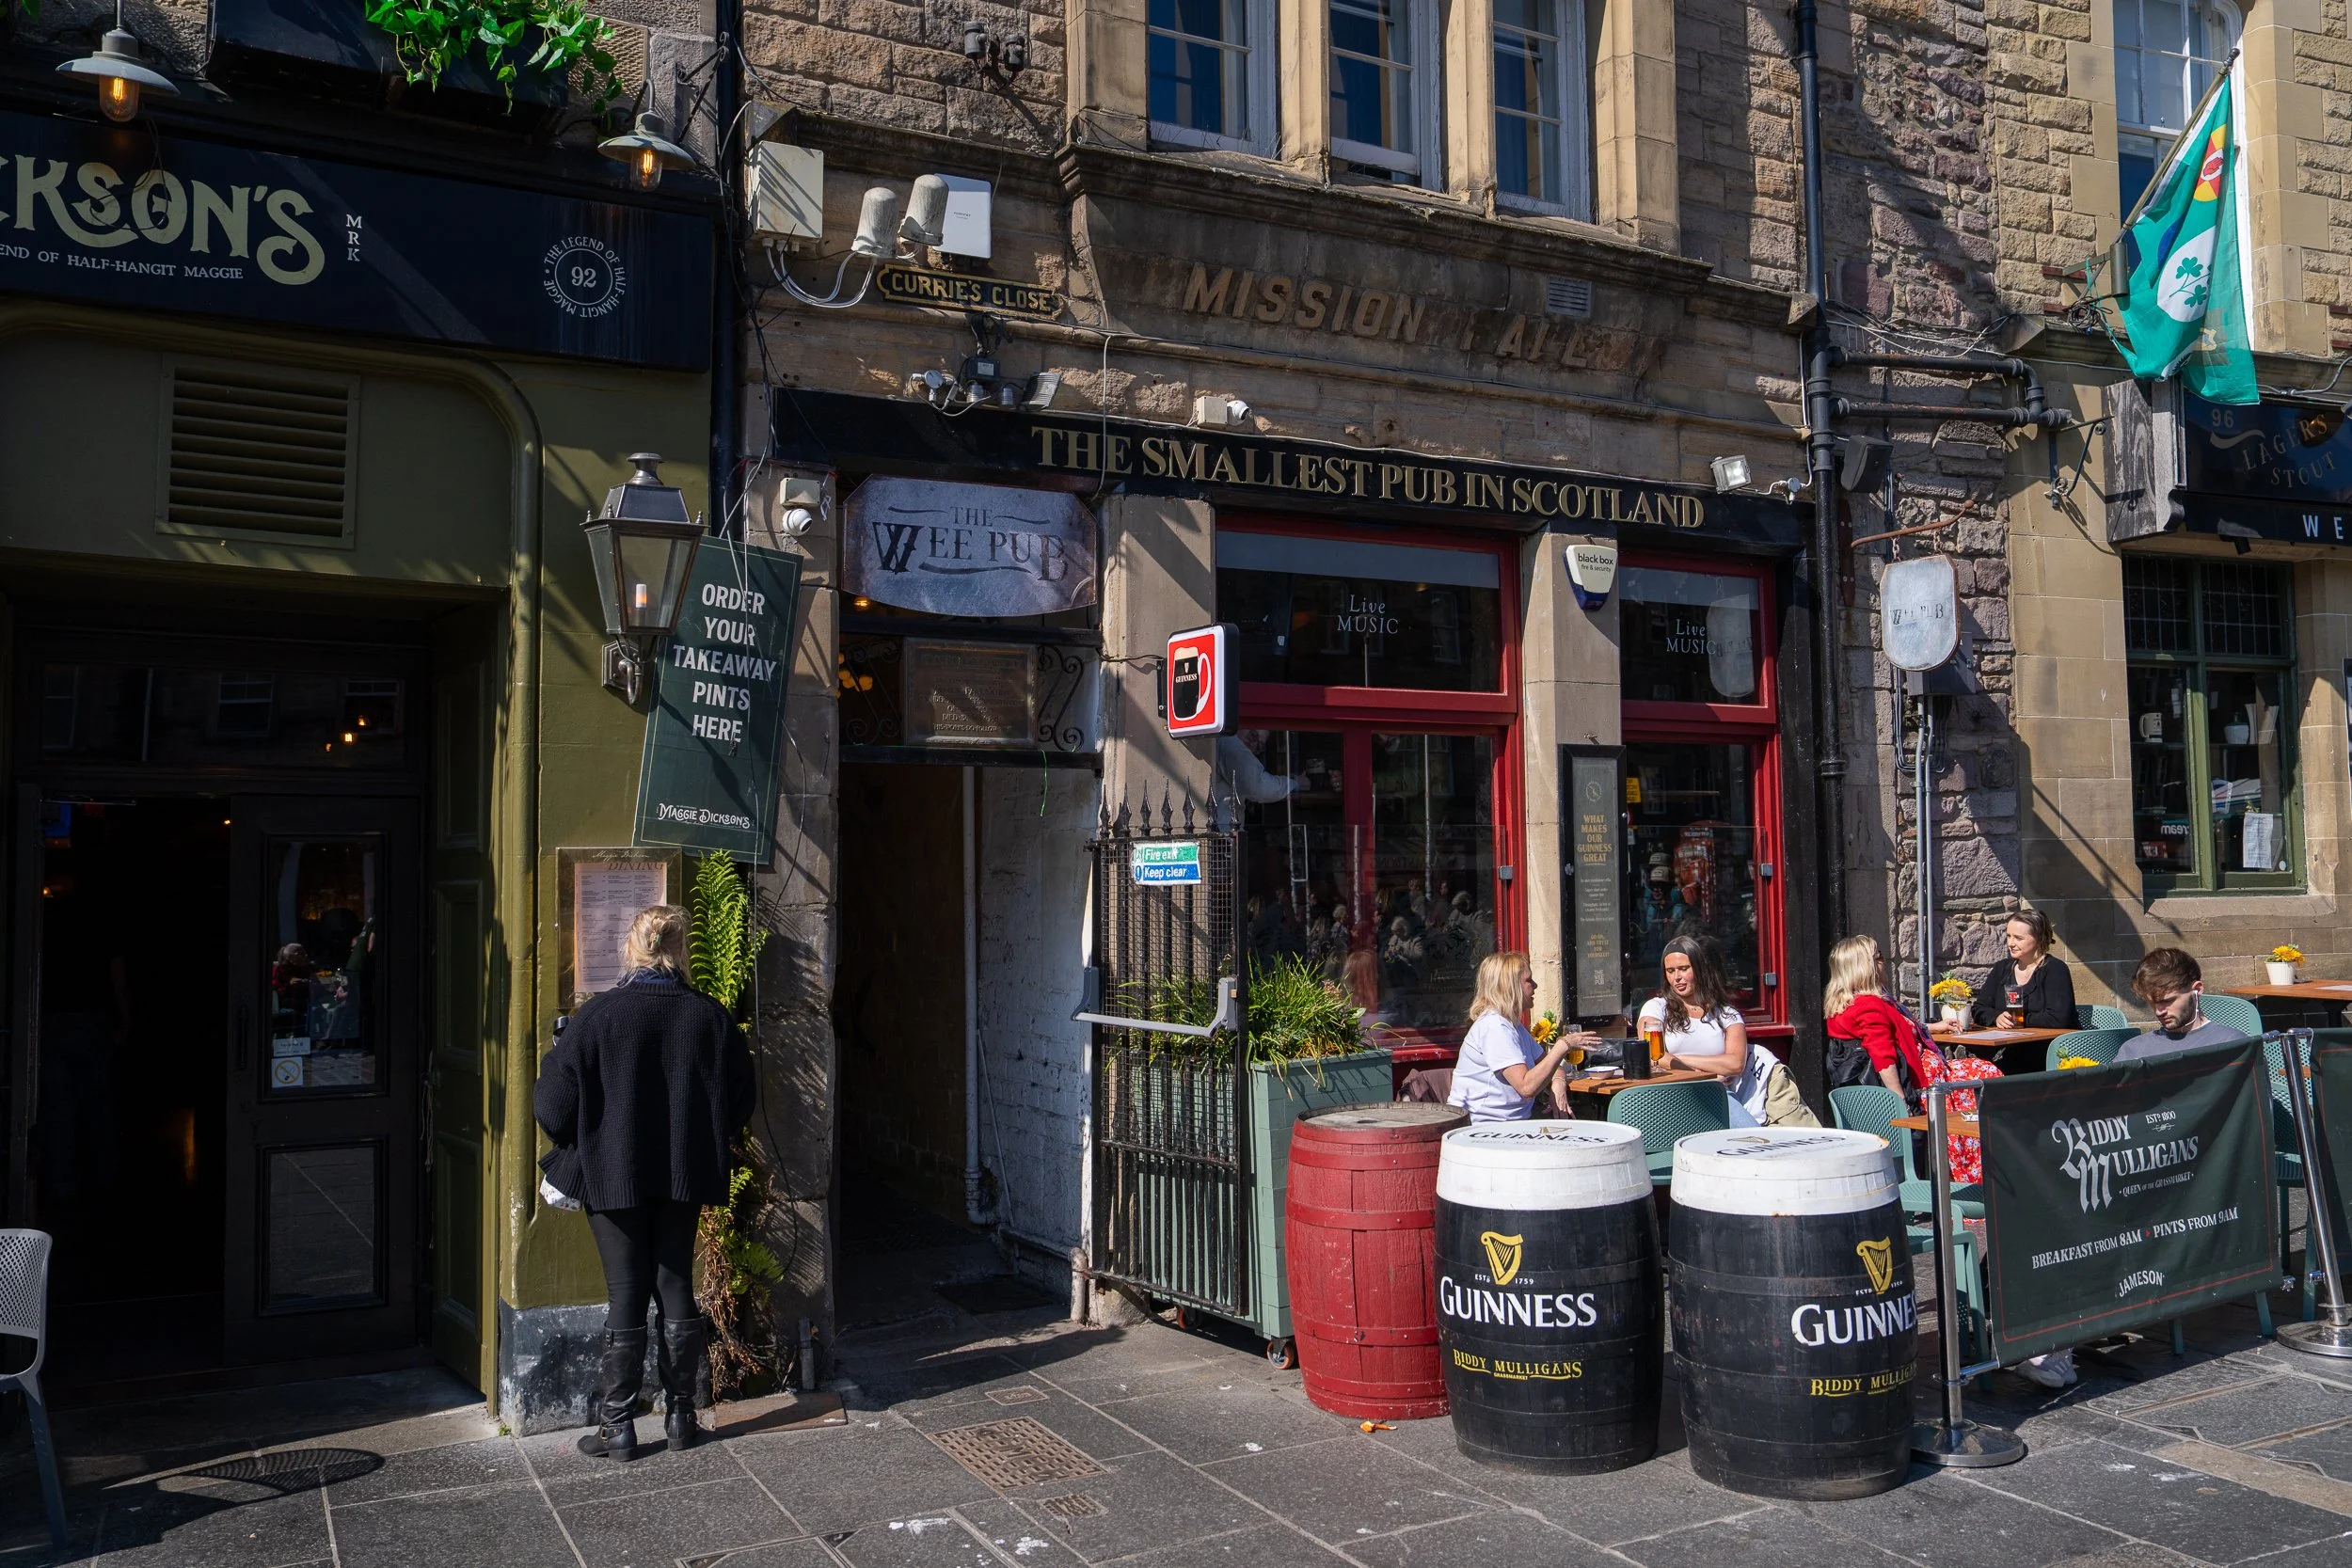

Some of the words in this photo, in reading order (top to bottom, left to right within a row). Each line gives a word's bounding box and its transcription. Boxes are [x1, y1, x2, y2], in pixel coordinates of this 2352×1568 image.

[0, 153, 326, 286] KSON'S
[544, 245, 564, 265] THE
[561, 236, 604, 251] LEGEND
[38, 250, 59, 263] OF
[68, 254, 177, 277] HALF-HANGIT
[183, 266, 244, 279] MAGGIE
[605, 250, 621, 263] OF
[571, 266, 596, 288] 92
[543, 279, 577, 315] MAGGIE
[580, 266, 627, 318] HALF-HANGIT
[891, 271, 981, 303] CURRIE'S
[992, 285, 1052, 313] CLOSE
[1181, 261, 1427, 344] MISSION
[2211, 407, 2234, 429] 96
[2241, 413, 2329, 471] LAGERS
[1031, 425, 1133, 476] THE
[1141, 436, 1374, 498] SMALLEST
[1378, 462, 1457, 505] PUB
[1463, 471, 1507, 511] IN
[1512, 476, 1706, 530] SCOTLAND
[2270, 451, 2337, 488] STOUT
[949, 506, 994, 528] THE
[872, 521, 975, 575] WEE
[988, 531, 1070, 582] PUB
[1578, 553, 1598, 564] black
[1599, 555, 1614, 565] box
[701, 582, 766, 616] ORDER
[1349, 594, 1386, 614] Live
[704, 615, 756, 647] YOUR
[1337, 614, 1399, 635] MUSIC
[1676, 618, 1707, 637] Live
[1666, 637, 1717, 655] MUSIC
[673, 644, 777, 682] TAKEAWAY
[1175, 673, 1198, 684] GUINNESS
[692, 681, 751, 712] PINTS
[691, 714, 743, 743] HERE
[658, 802, 698, 821] MAGGIE
[698, 809, 751, 829] DICKSON'S
[1583, 815, 1605, 824] WHAT
[1581, 824, 1608, 833] MAKES
[1586, 833, 1603, 843] OUR
[1145, 848, 1160, 861] Fire
[1577, 843, 1613, 853] GUINNESS
[1582, 852, 1607, 863] GREAT
[608, 862, 664, 871] DINING
[1144, 866, 1165, 879] Keep
[1167, 866, 1187, 878] clear
[1468, 1131, 1610, 1144] GUINNESS
[2051, 1114, 2132, 1180] BIDDY
[2077, 1135, 2200, 1214] MULLIGANS
[2122, 1183, 2142, 1197] QUEEN
[2031, 1242, 2094, 1270] BREAKFAST
[2093, 1236, 2118, 1254] FROM
[2119, 1228, 2143, 1247] 8AM
[2153, 1219, 2187, 1239] PINTS
[2186, 1213, 2217, 1230] FROM
[2217, 1207, 2239, 1224] 9AM
[2118, 1270, 2164, 1298] JAMESON
[1439, 1275, 1597, 1328] GUINNESS
[1790, 1289, 1917, 1347] GUINNES
[1453, 1348, 1486, 1369] BIDDY
[1494, 1360, 1582, 1378] MULLIGANS
[1810, 1378, 1862, 1396] BIDDY
